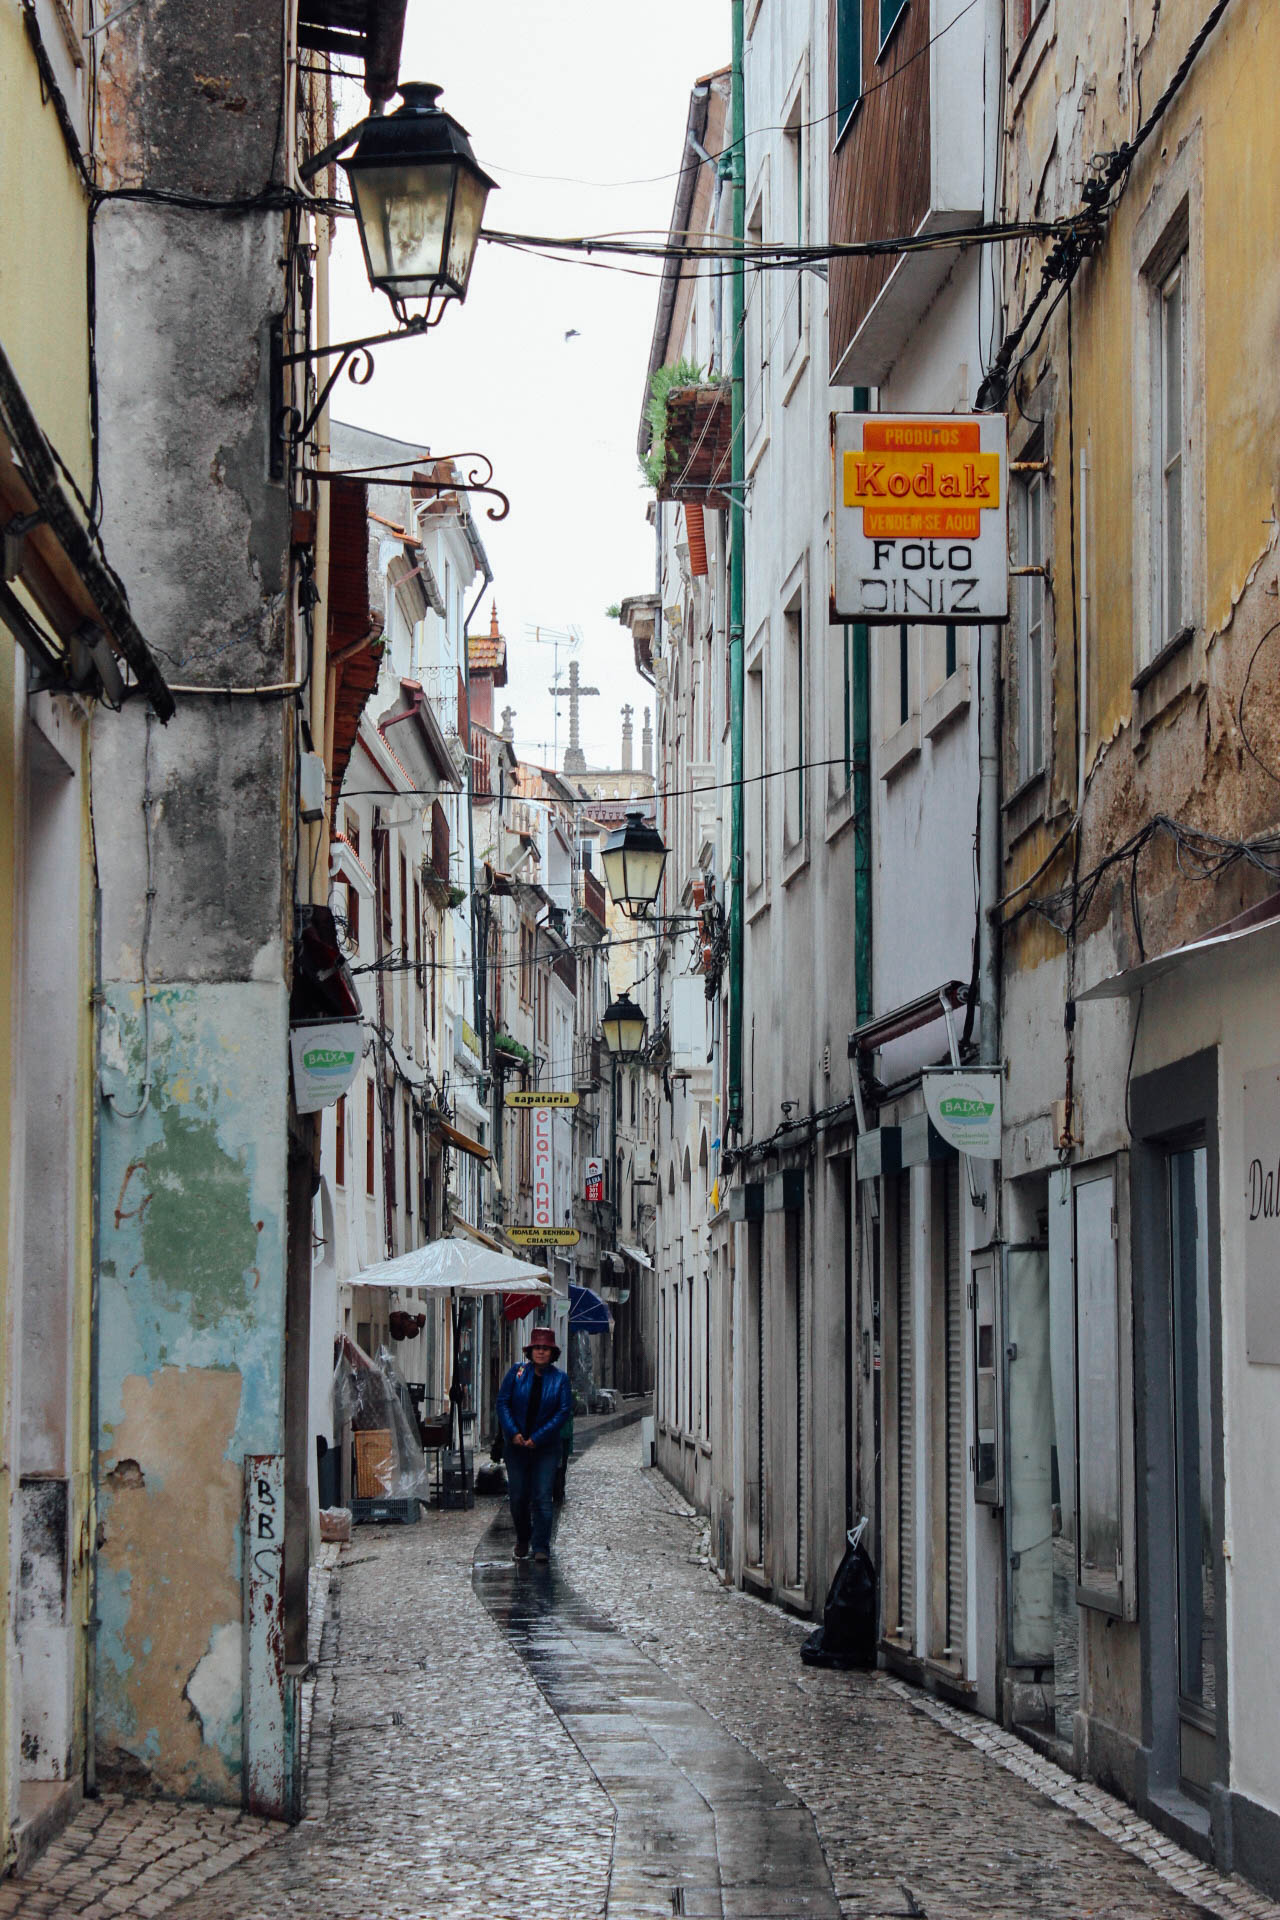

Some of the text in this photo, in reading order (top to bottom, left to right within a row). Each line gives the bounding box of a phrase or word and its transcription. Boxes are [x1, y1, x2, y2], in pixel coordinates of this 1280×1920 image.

[885, 429, 959, 445] PRODUTOS
[855, 462, 991, 498] Kodak
[869, 514, 976, 531] VENDEM-SE AQUI
[308, 1052, 347, 1064] BAIXA
[514, 1094, 570, 1104] sapataria
[945, 1101, 986, 1113] BAIXA
